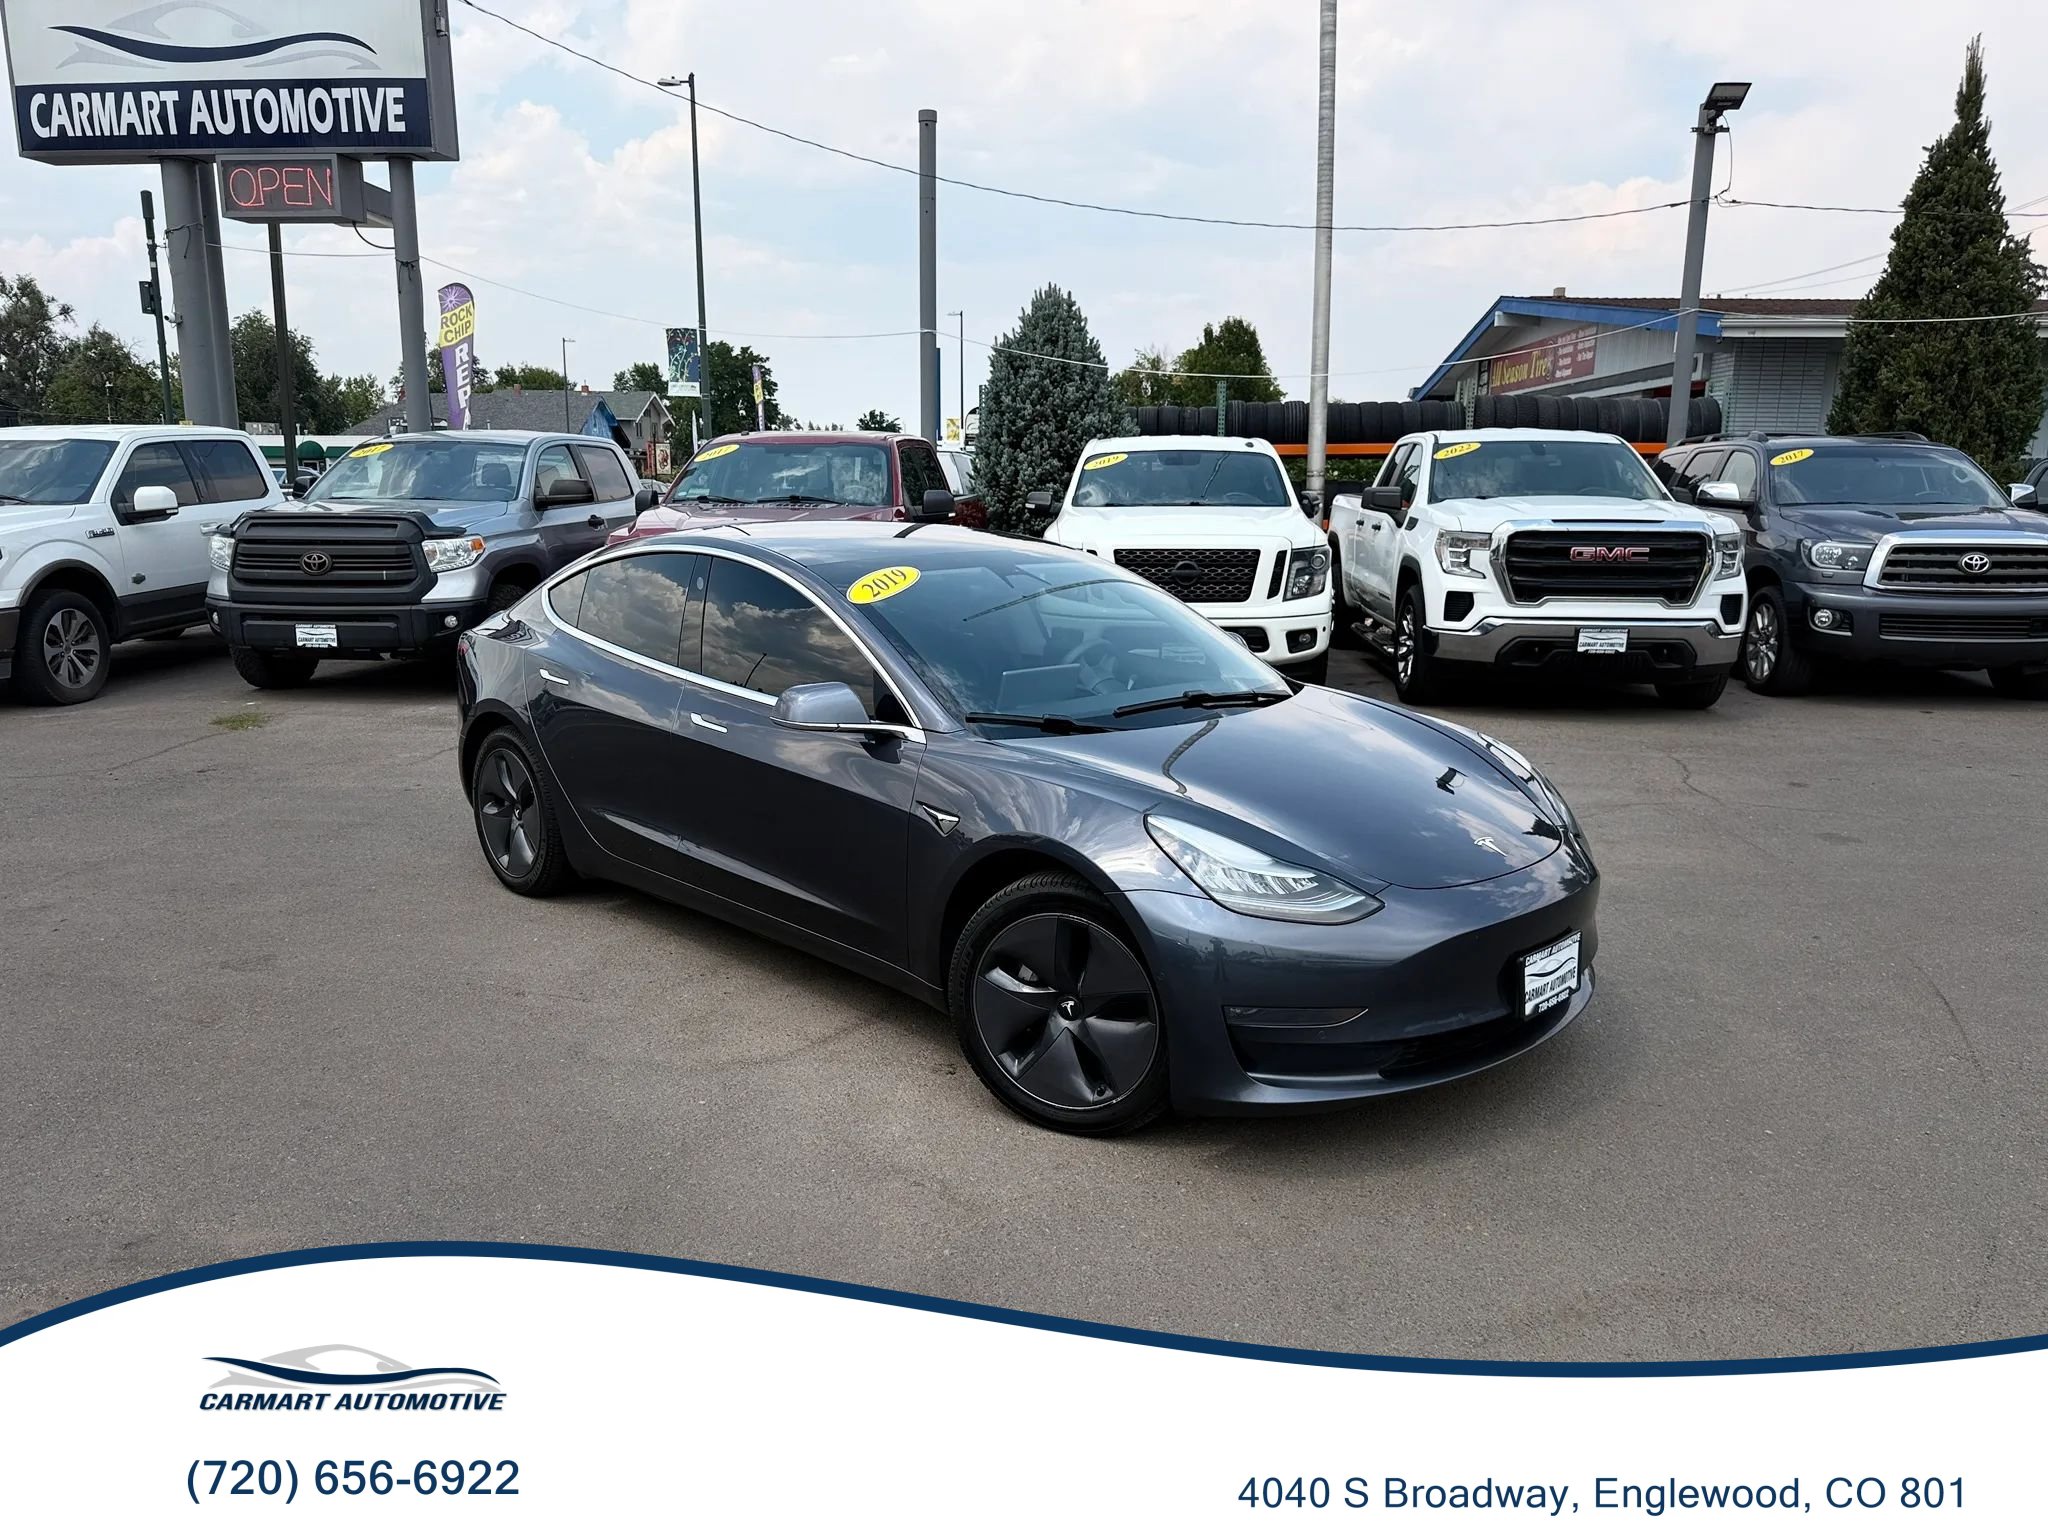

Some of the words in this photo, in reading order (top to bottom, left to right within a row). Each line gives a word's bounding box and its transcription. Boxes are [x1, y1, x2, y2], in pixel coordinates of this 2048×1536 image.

[29, 90, 180, 138] CARMART
[189, 87, 406, 135] AUTOMOTIVE
[229, 167, 333, 207] OPEN
[440, 305, 473, 329] ROCK
[444, 320, 472, 343] CHIP
[1491, 360, 1503, 387] All
[1503, 360, 1529, 385] Season
[1093, 455, 1120, 468] 2019
[1444, 443, 1472, 457] 2022
[1779, 450, 1804, 464] 2017
[1570, 546, 1650, 562] GMC
[861, 569, 907, 598] 2019
[1525, 948, 1552, 967] CARMART
[1525, 981, 1549, 1003] CARMART
[1549, 966, 1576, 992] AUTOMOTIVE
